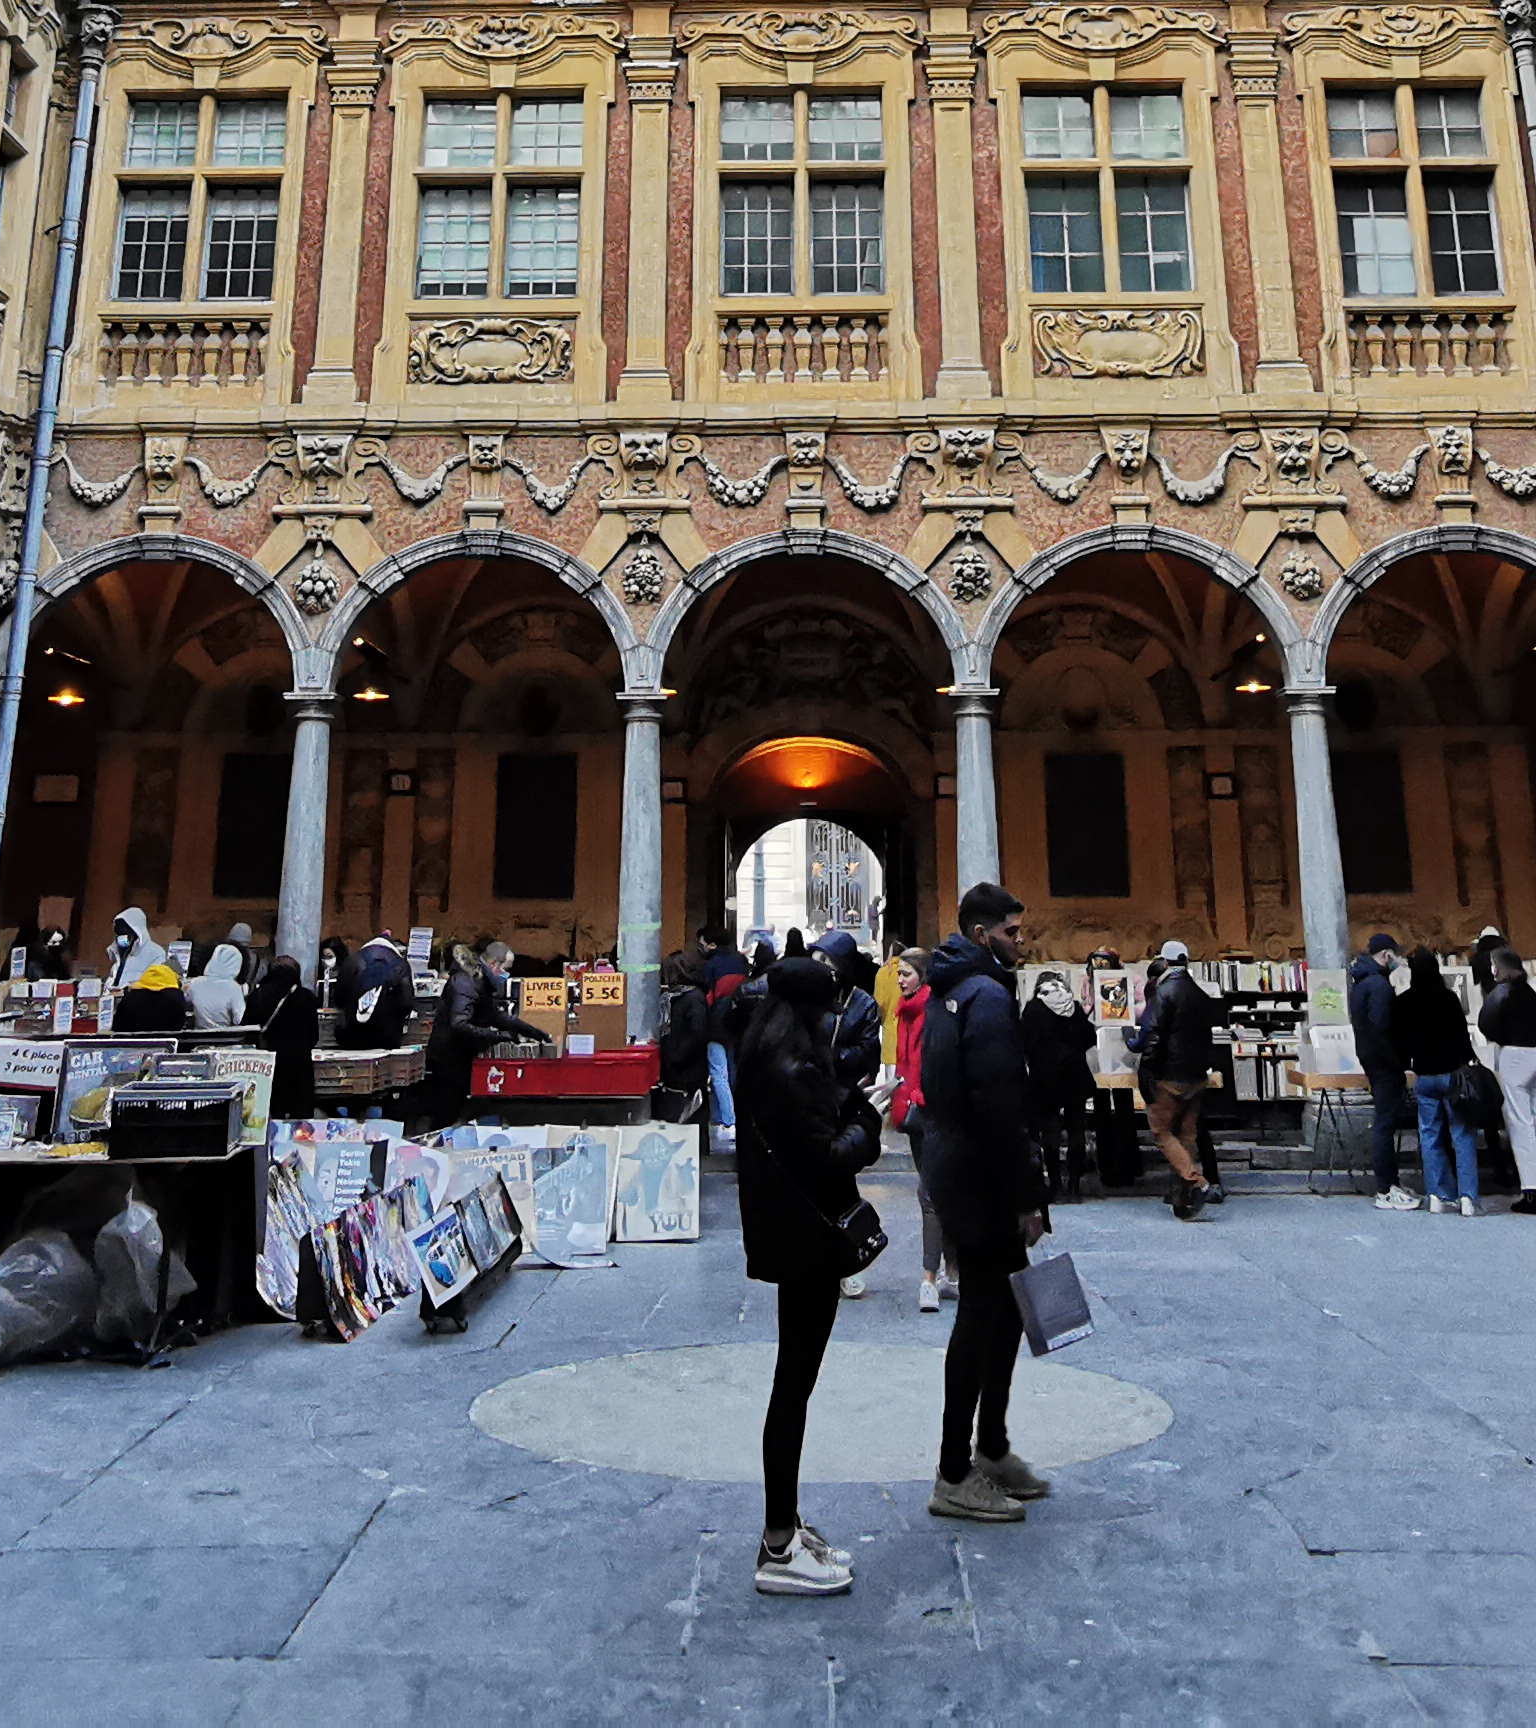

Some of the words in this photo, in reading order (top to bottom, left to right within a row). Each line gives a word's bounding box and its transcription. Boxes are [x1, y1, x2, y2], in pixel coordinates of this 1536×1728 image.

[584, 975, 621, 984] POLICIER
[526, 982, 563, 991] LIVRES
[4, 1061, 12, 1071] 3
[13, 1064, 38, 1073] pour
[217, 1059, 272, 1076] CHICKENS
[463, 1153, 526, 1166] UHAMMAD
